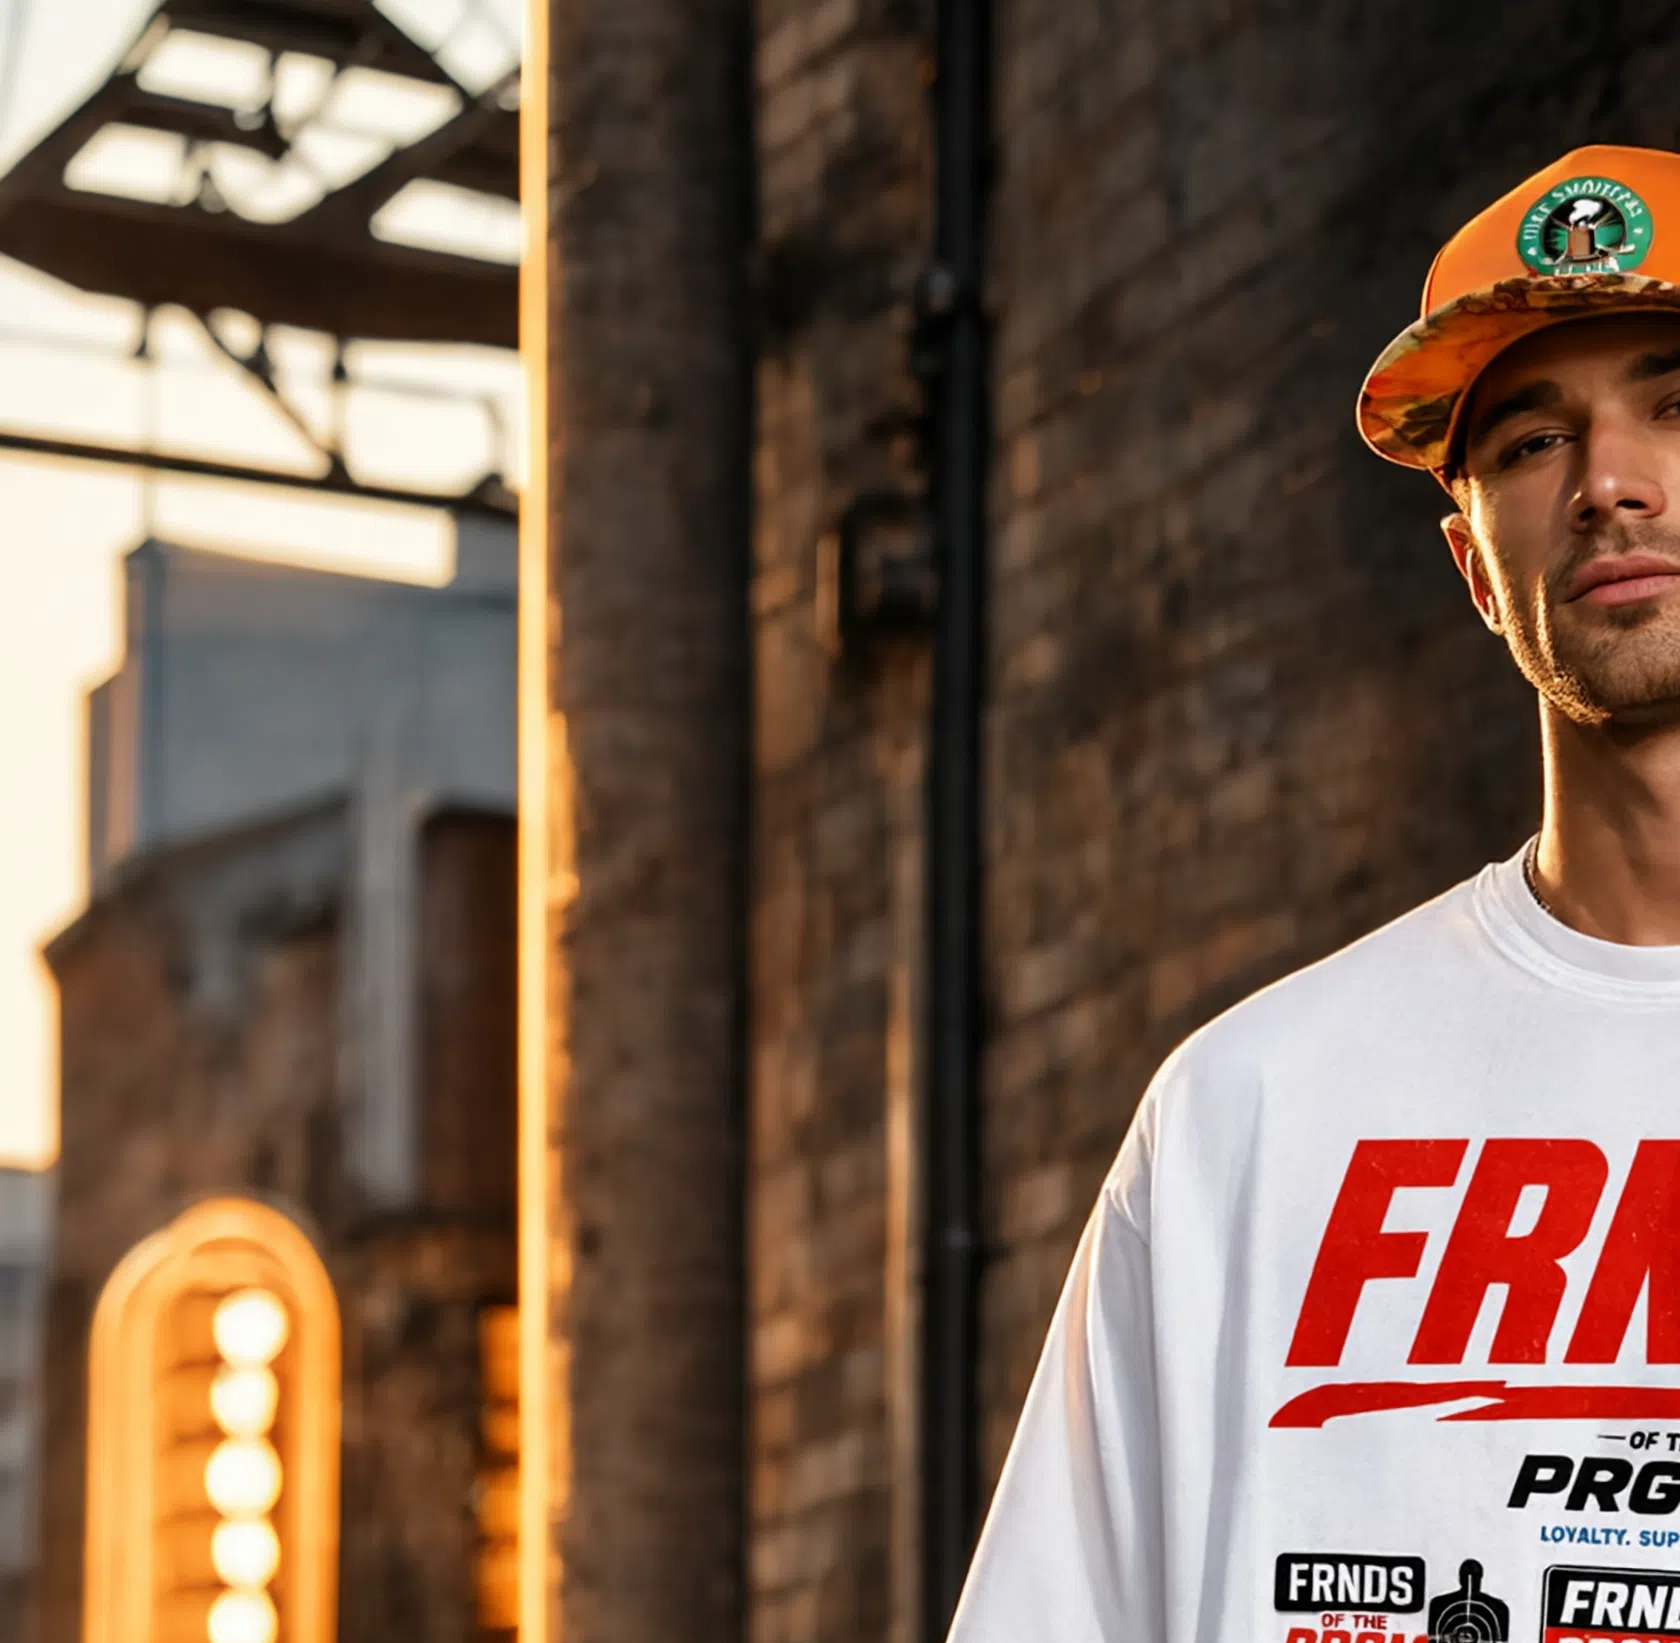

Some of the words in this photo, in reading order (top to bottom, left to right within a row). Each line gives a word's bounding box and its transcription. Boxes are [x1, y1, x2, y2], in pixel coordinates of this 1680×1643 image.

[1629, 1431, 1660, 1450] OF
[1540, 1526, 1630, 1546] LOYALTY.
[1288, 1563, 1414, 1606] FRNDS
[1321, 1613, 1347, 1629] OF
[1351, 1614, 1388, 1630] THE
